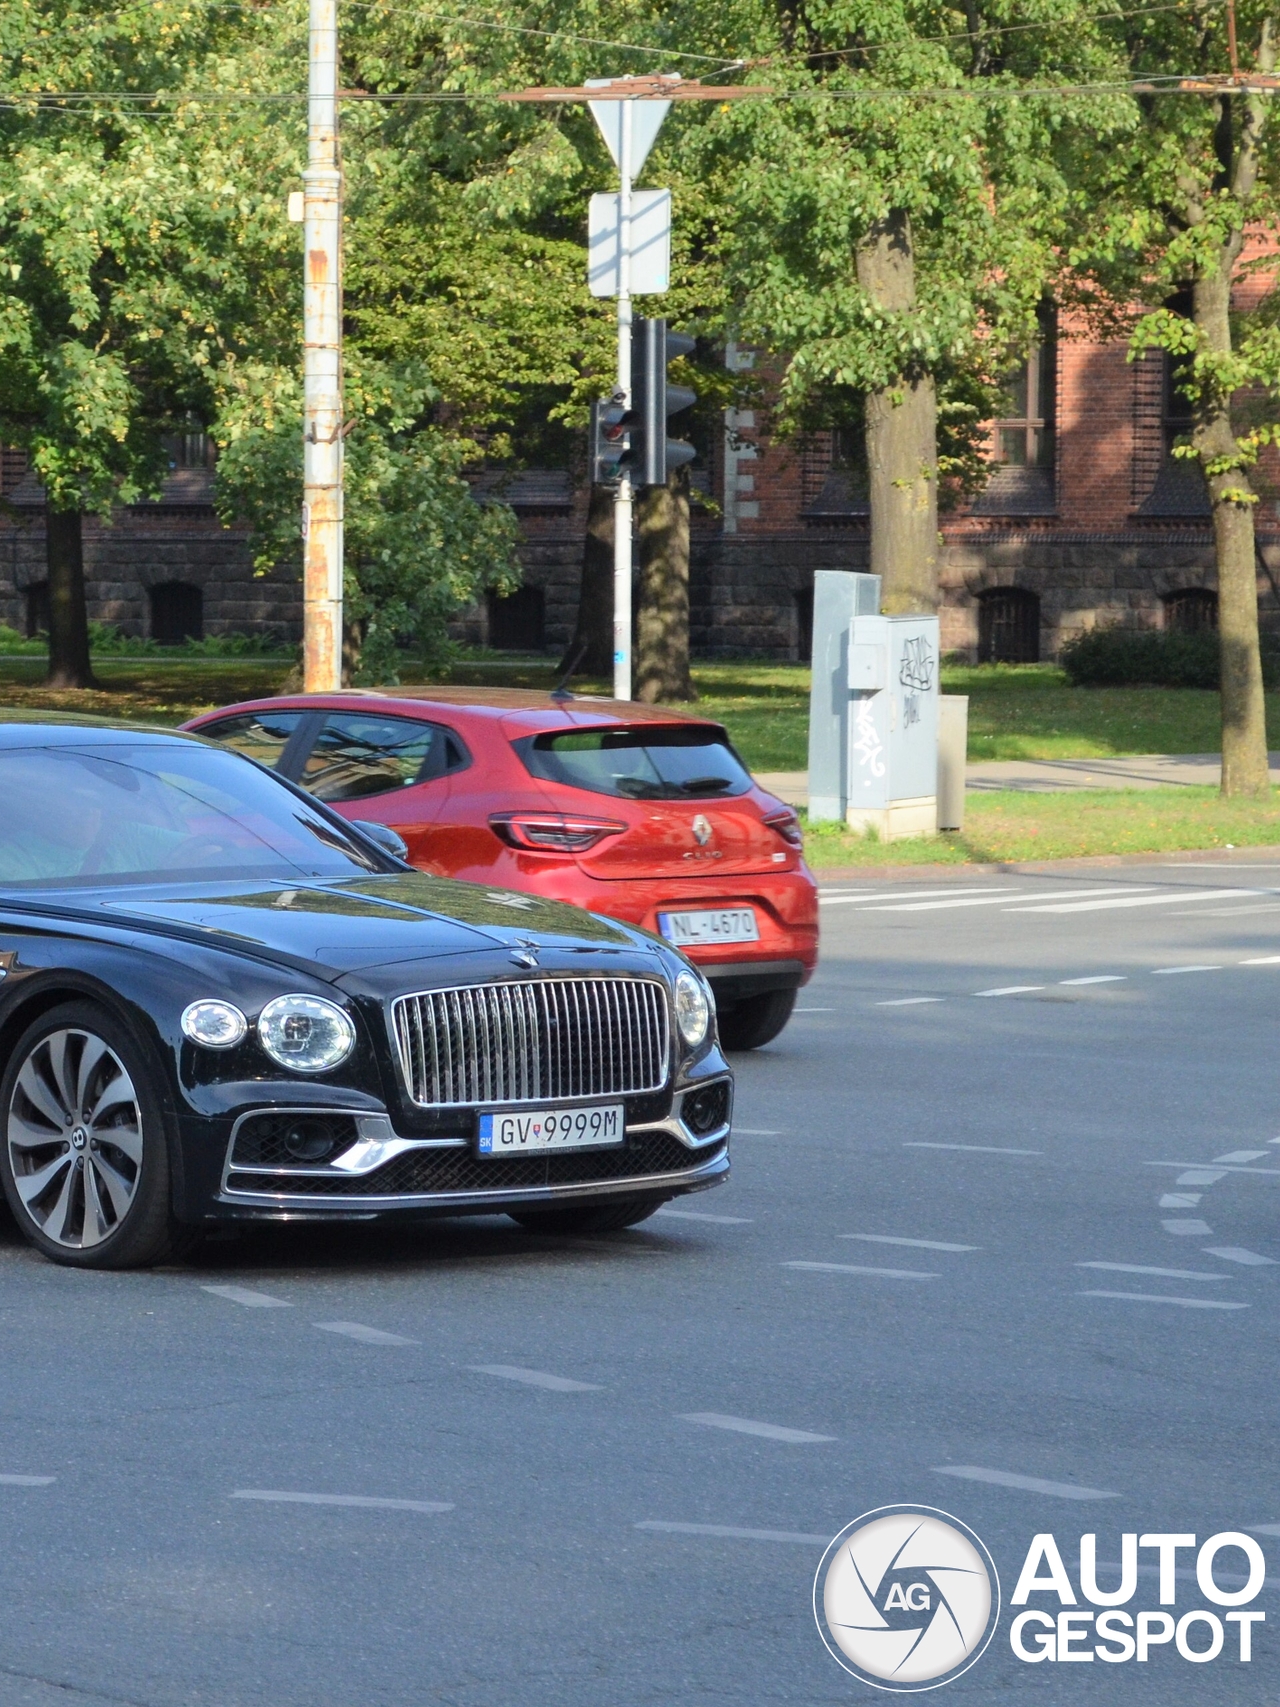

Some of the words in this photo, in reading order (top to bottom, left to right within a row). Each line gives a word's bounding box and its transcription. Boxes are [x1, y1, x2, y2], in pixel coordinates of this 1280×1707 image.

[672, 912, 753, 937] NL-4670
[501, 1118, 532, 1145] GV
[544, 1110, 618, 1142] 9999M
[480, 1136, 492, 1148] SK
